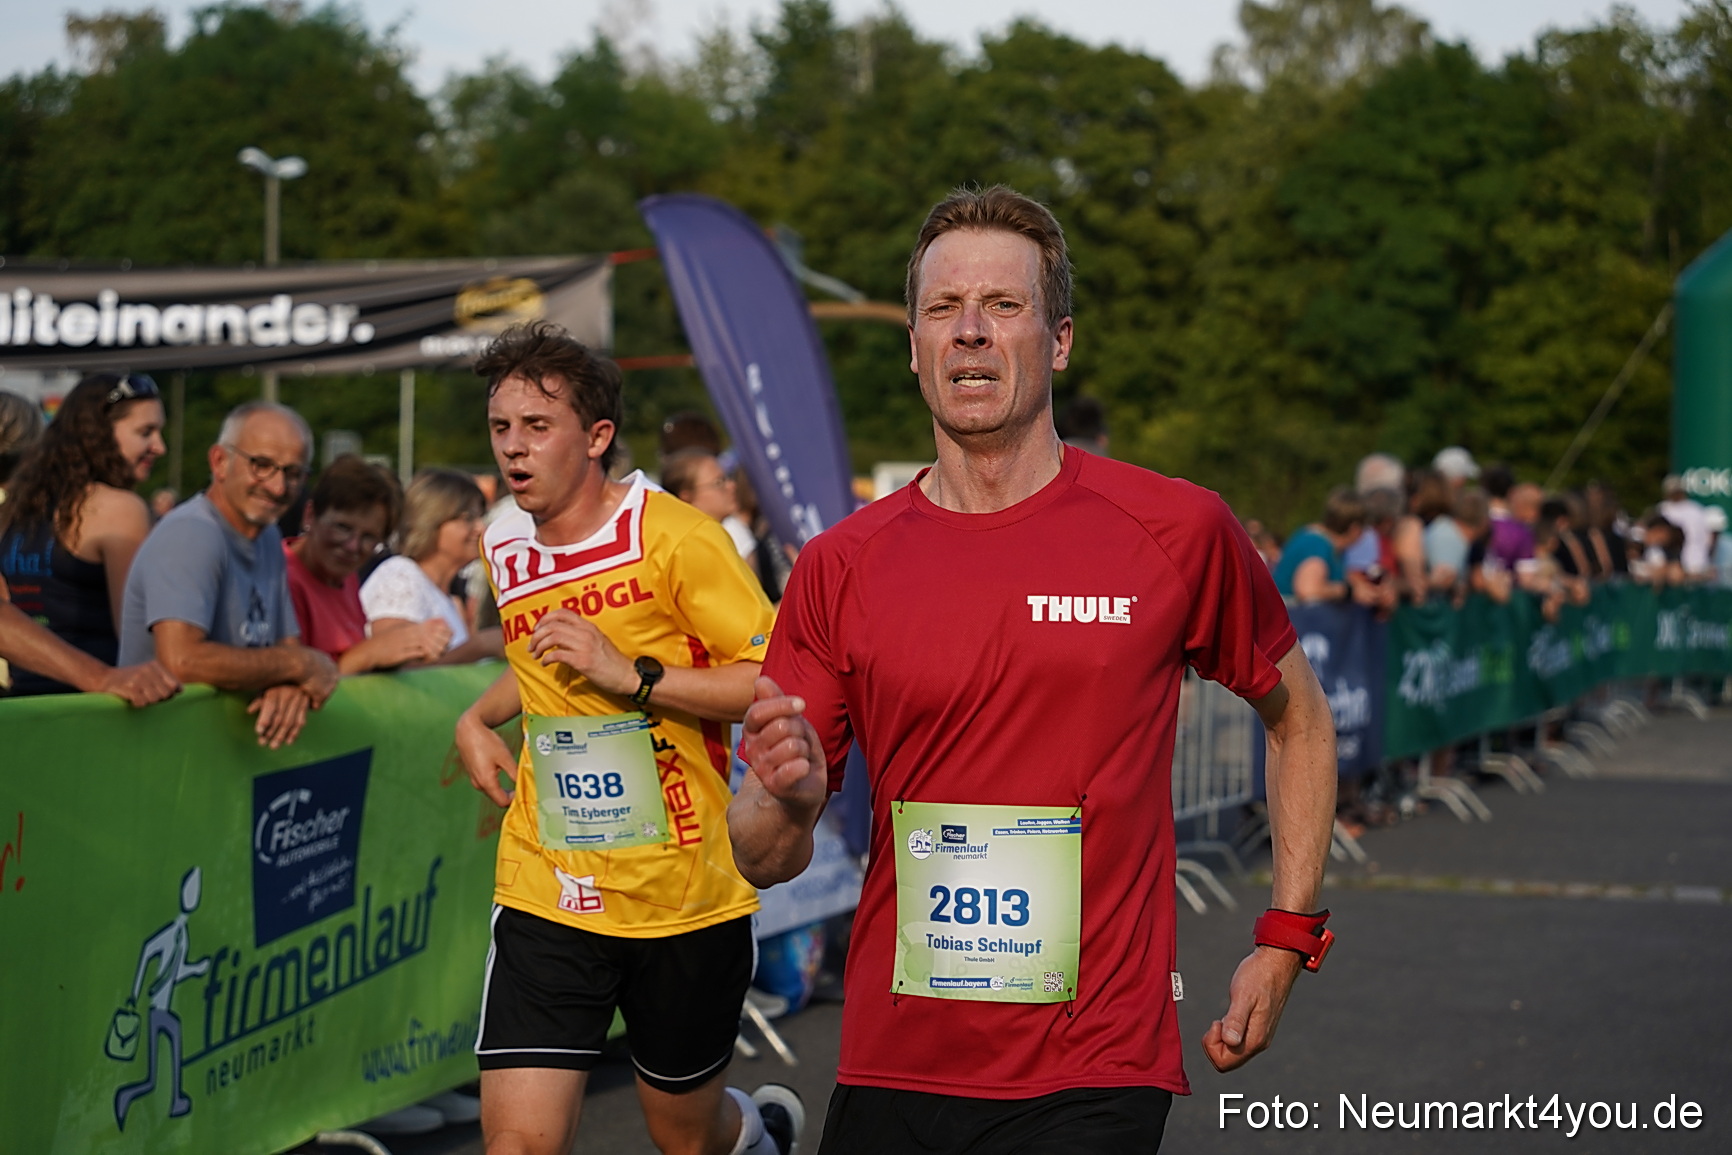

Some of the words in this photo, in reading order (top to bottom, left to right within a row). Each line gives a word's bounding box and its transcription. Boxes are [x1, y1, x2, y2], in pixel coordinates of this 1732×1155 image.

[561, 577, 654, 617] BÖGL
[1027, 595, 1131, 624] THULE
[554, 772, 624, 800] 1638
[562, 806, 579, 817] Tim
[581, 806, 632, 820] Eyberger
[270, 806, 350, 853] Fischer
[936, 843, 989, 853] Firmenlauf
[930, 885, 1030, 927] 2813
[205, 856, 442, 1050] firmenlauf
[926, 933, 973, 951] Tobias
[978, 937, 1042, 957] Schlupf
[932, 980, 988, 988] firmenlauf.bayern
[206, 1012, 316, 1096] neumarkt
